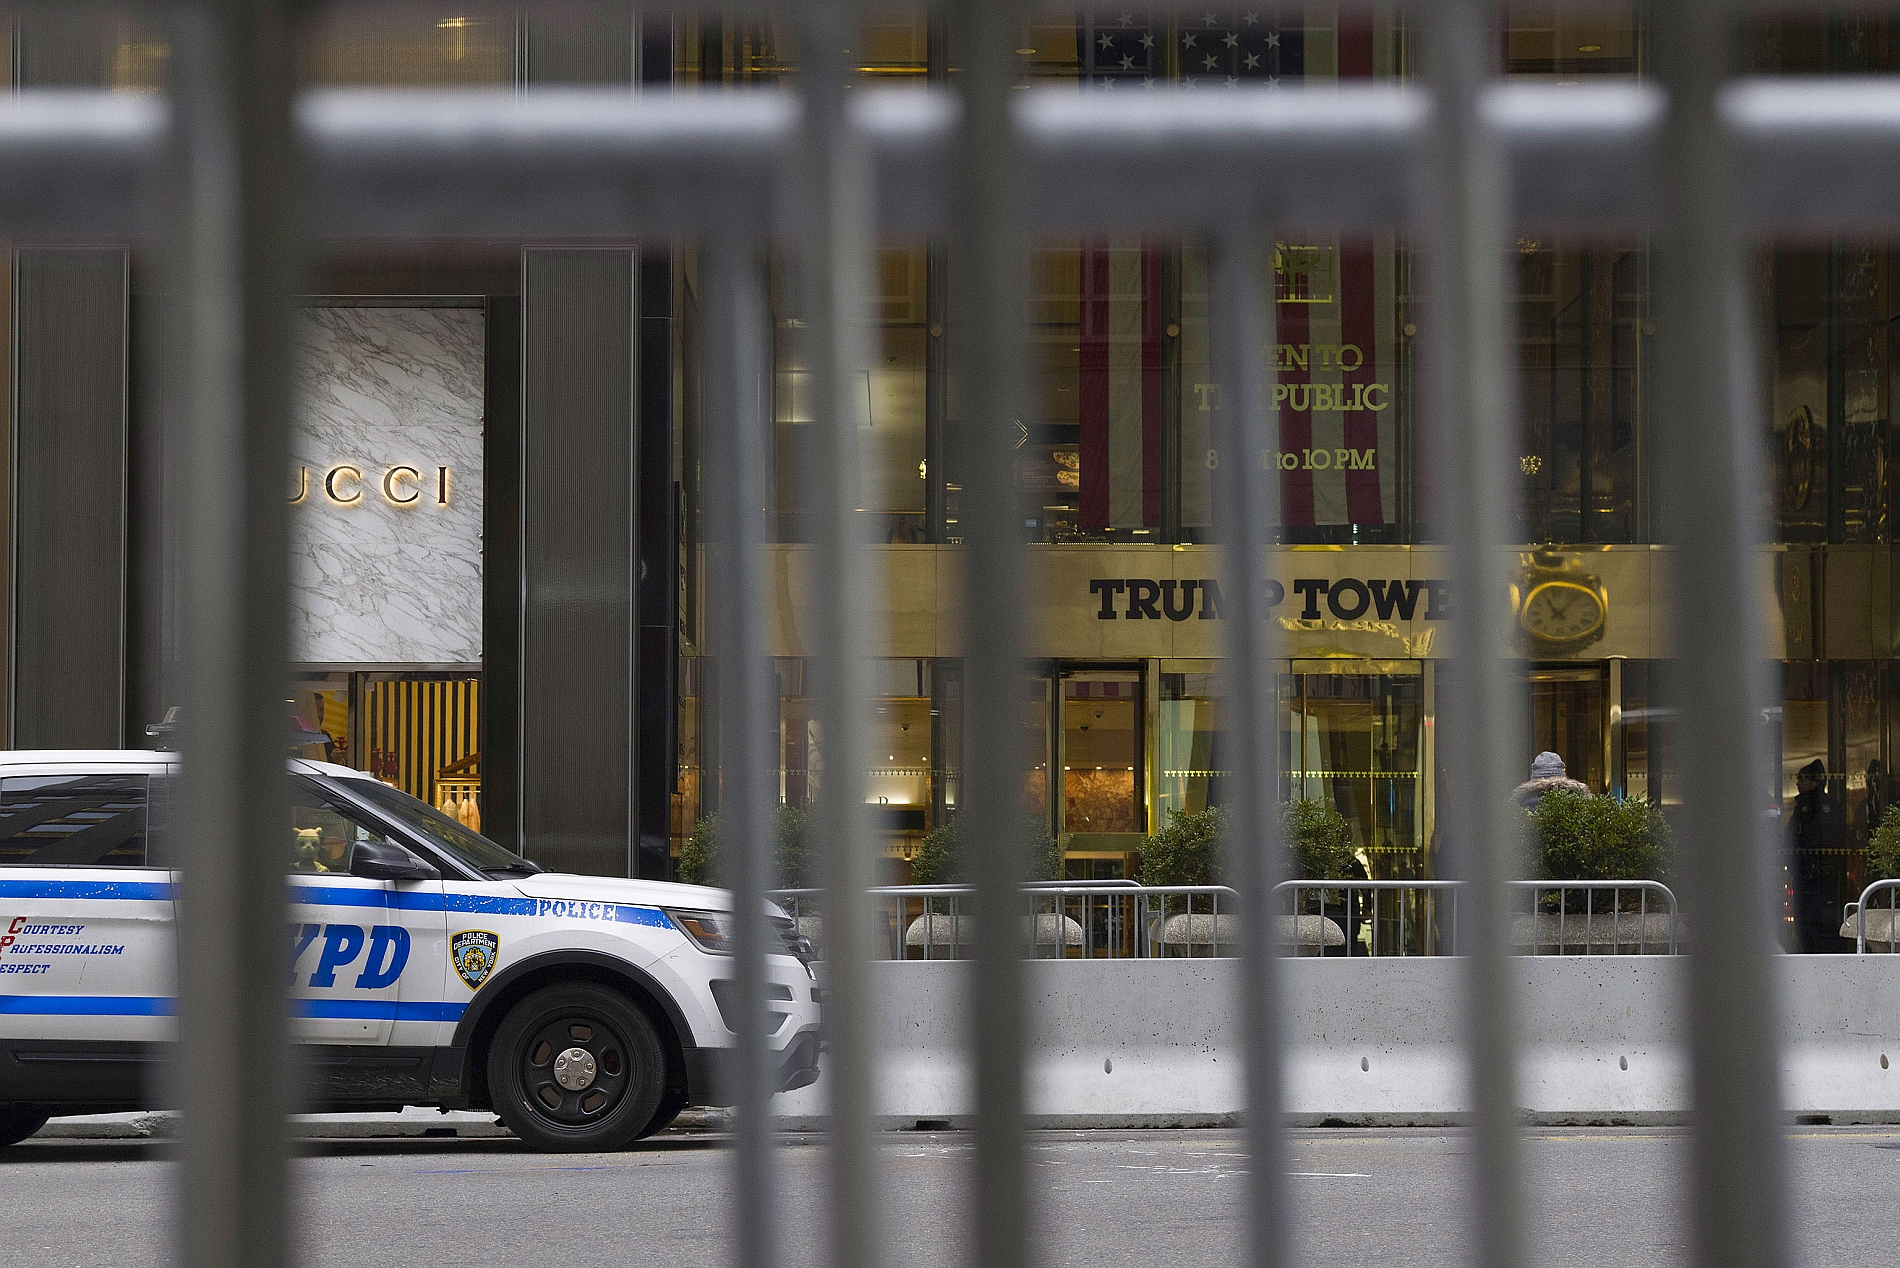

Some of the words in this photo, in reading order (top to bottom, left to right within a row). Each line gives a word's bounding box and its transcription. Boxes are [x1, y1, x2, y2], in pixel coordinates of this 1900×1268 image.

[1265, 344, 1311, 371] EN
[1315, 344, 1364, 372] TO
[1268, 383, 1389, 412] PUBLIC
[1334, 449, 1376, 470] PM
[1293, 577, 1447, 621] TOWE
[539, 899, 615, 921] POLICE
[8, 916, 85, 935] COURTESY
[453, 939, 496, 950] DEPARTMENT
[284, 924, 413, 990] YPD
[454, 957, 463, 971] CITY
[461, 972, 469, 980] OF
[477, 970, 489, 983] NEW
[487, 951, 496, 969] YORK
[0, 964, 50, 974] ESPECT
